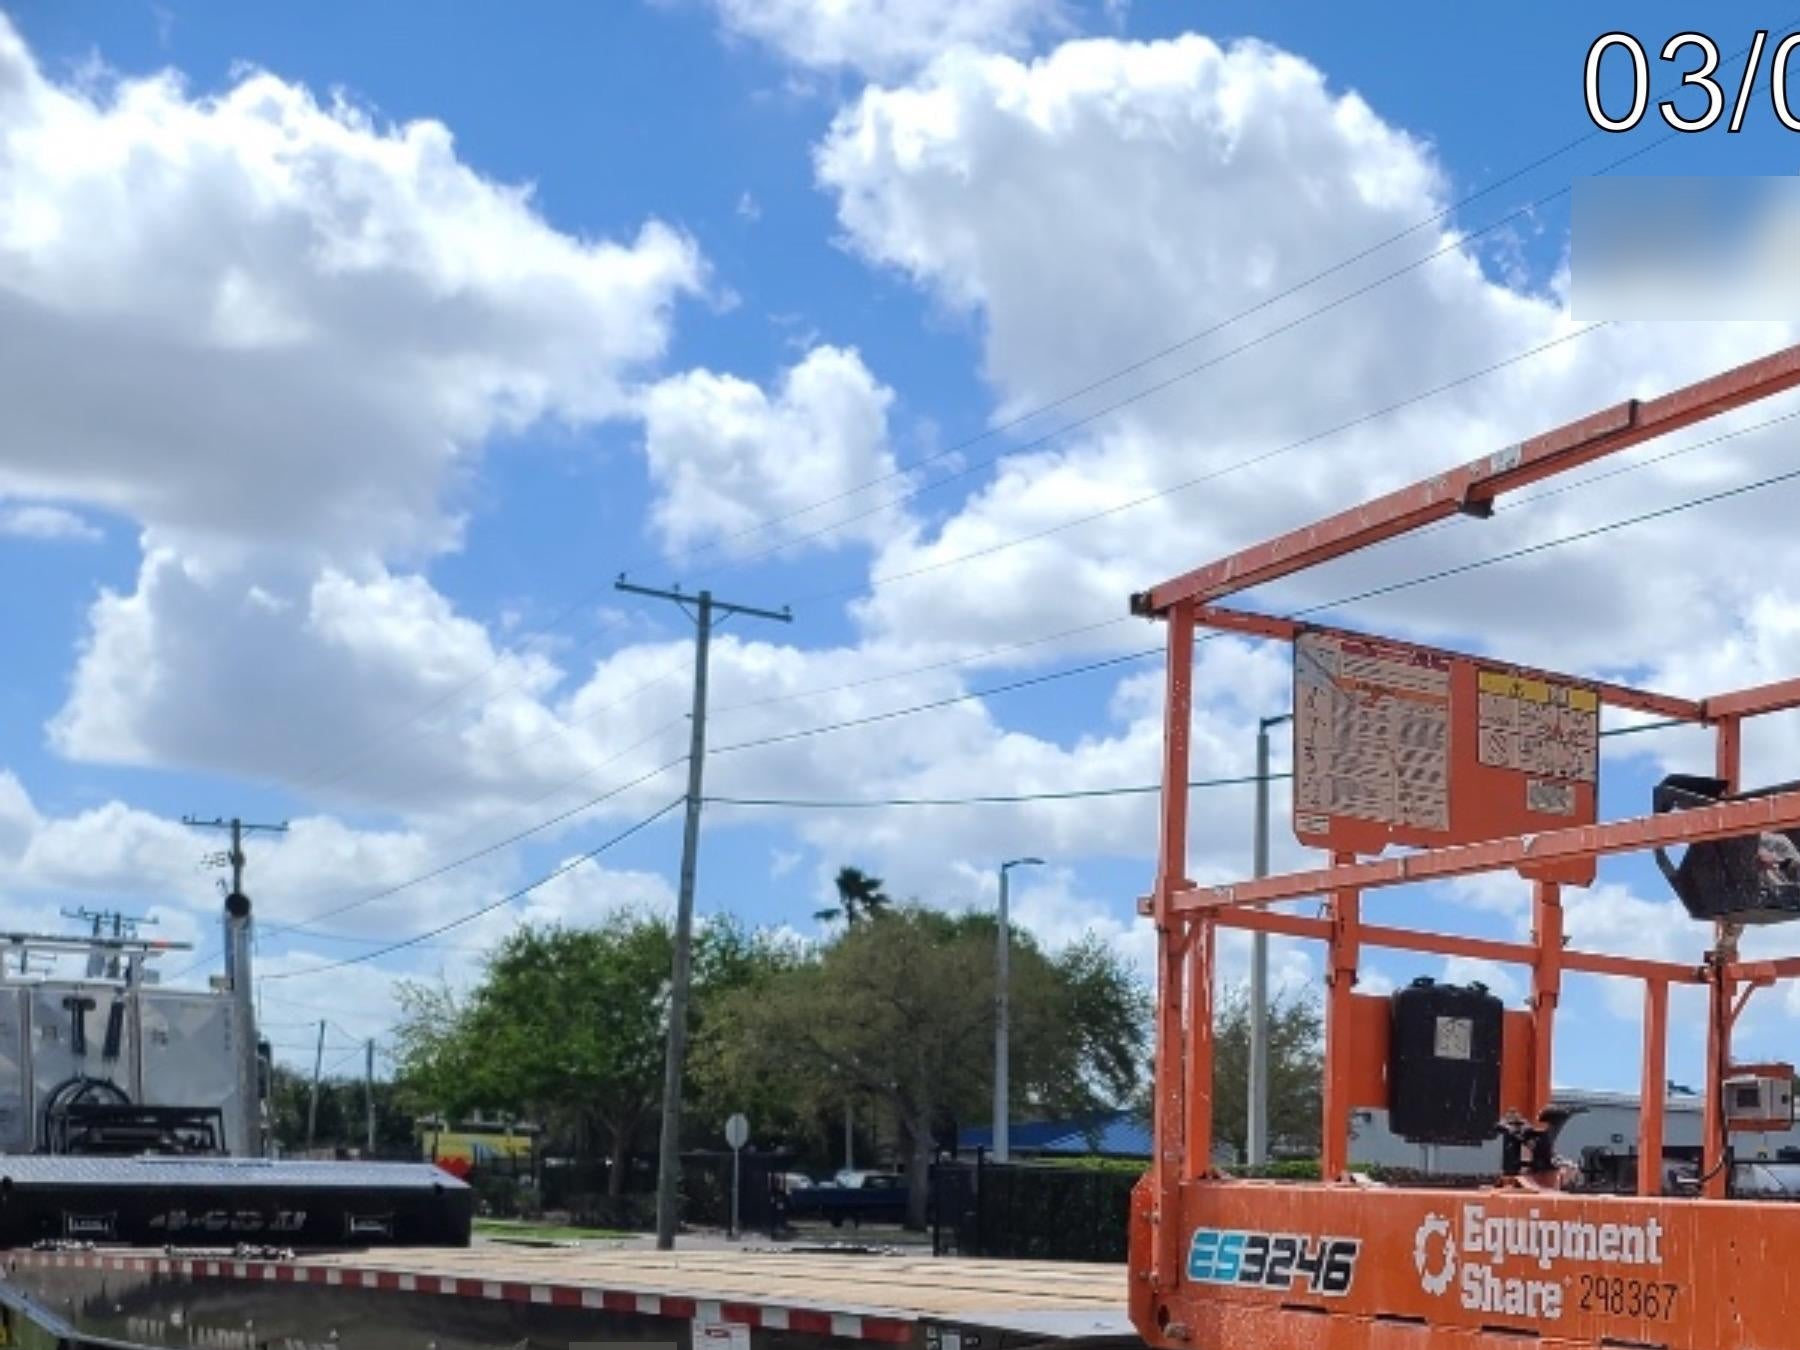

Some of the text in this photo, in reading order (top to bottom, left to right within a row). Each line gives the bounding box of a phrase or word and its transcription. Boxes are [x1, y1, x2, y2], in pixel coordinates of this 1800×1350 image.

[1187, 1227, 1362, 1297] ES3246
[1462, 1204, 1662, 1267] Equipment
[1461, 1263, 1562, 1319] Share
[1580, 1274, 1678, 1321] 298367
